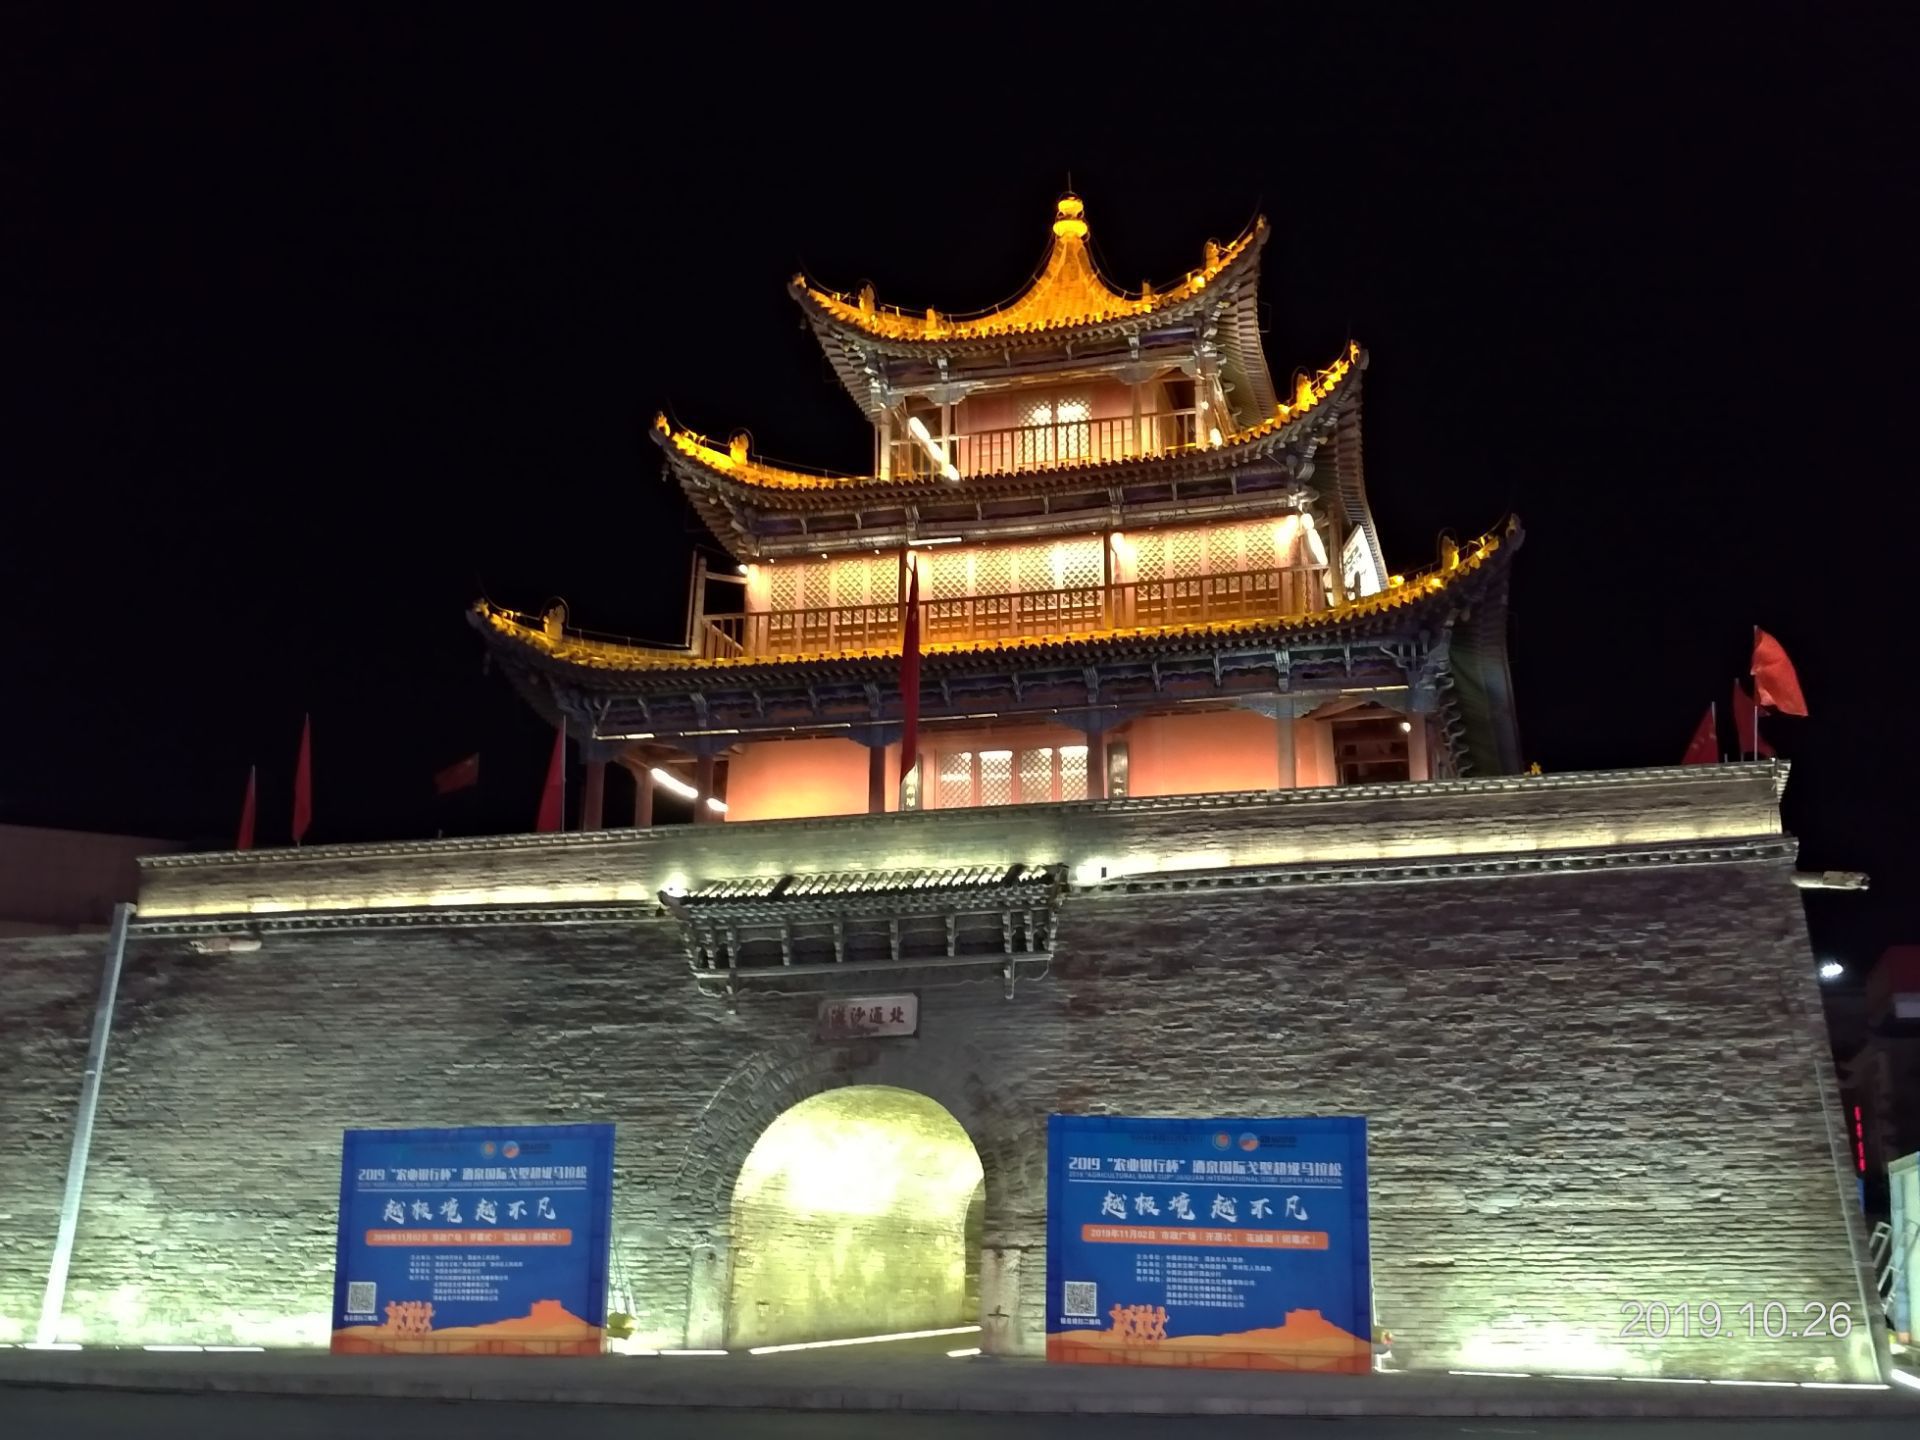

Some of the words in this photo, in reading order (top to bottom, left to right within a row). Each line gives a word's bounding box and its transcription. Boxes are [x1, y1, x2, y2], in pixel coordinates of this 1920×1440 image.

[1069, 1157, 1100, 1171] 2019
[358, 1168, 385, 1181] 2019
[1210, 1194, 1308, 1223] 越不凡
